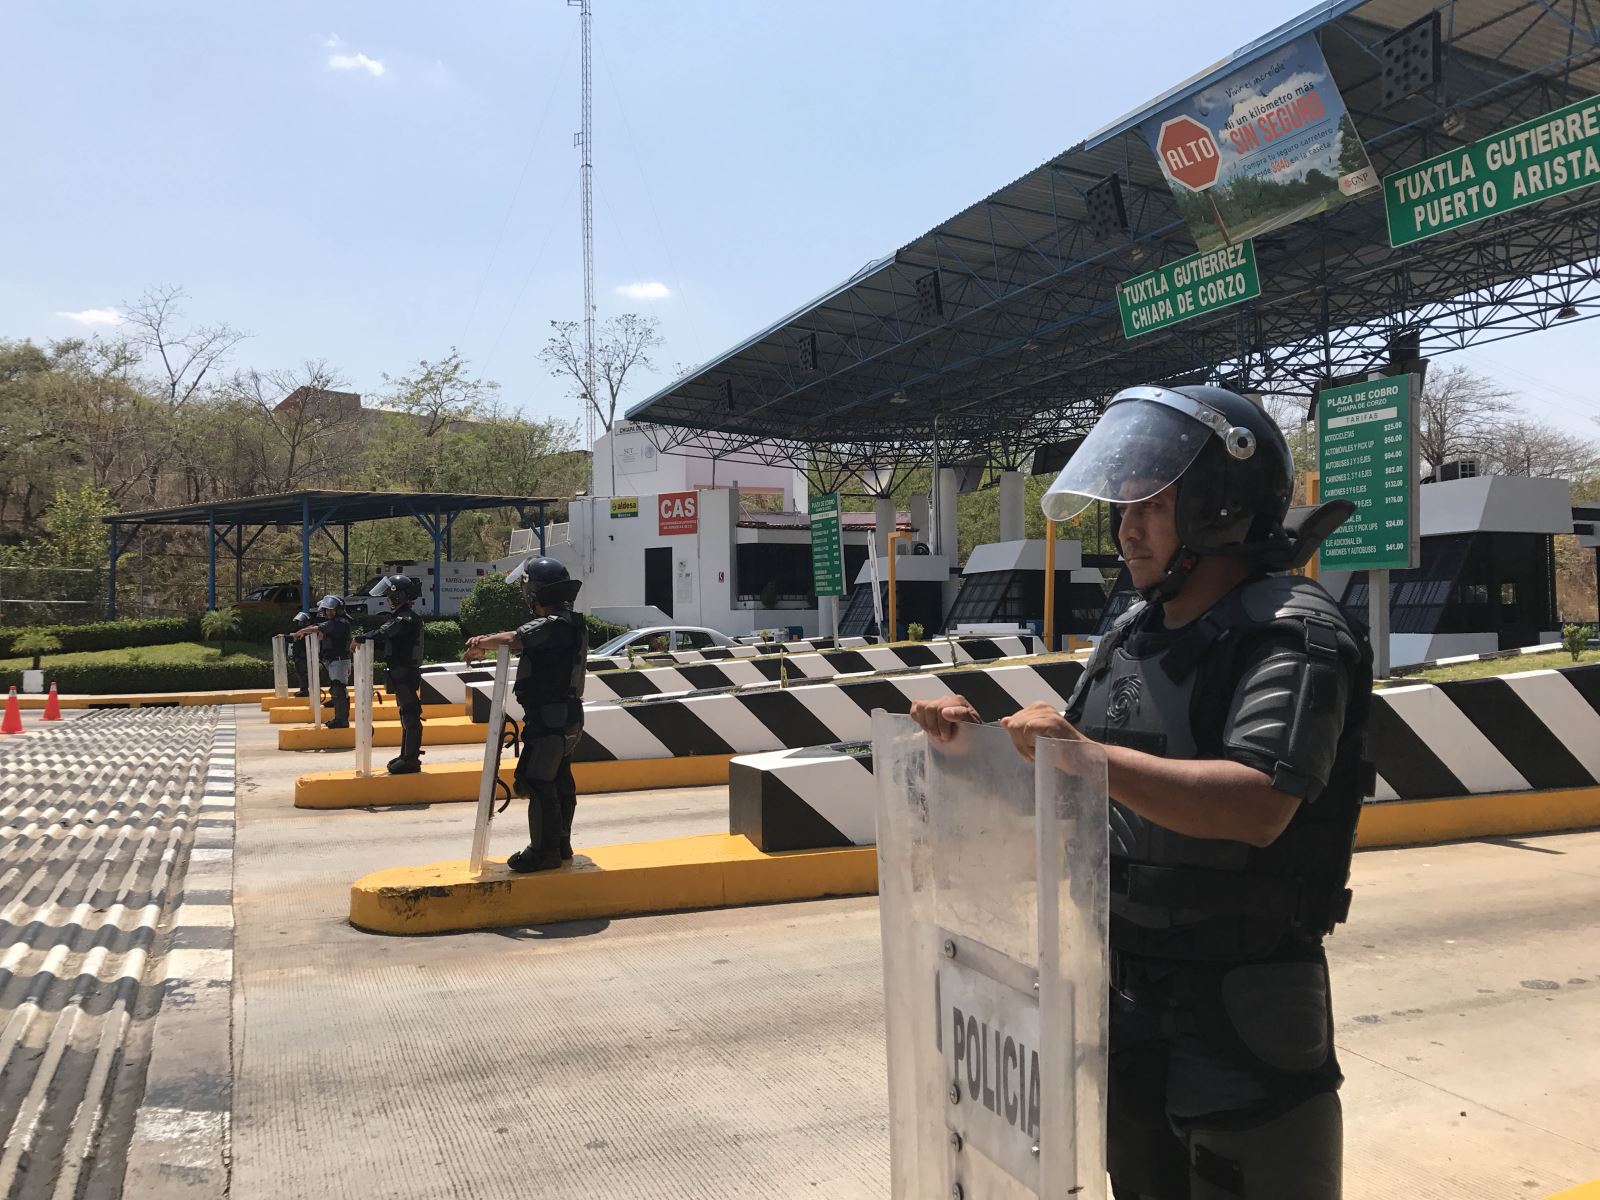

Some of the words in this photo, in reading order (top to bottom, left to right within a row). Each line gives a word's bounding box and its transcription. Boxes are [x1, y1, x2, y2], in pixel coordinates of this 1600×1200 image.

[1224, 118, 1234, 131] Ni
[1236, 114, 1248, 125] un
[1248, 92, 1293, 119] kilómetro
[1295, 81, 1315, 97] más
[1229, 123, 1260, 155] SIN
[1257, 90, 1326, 143] SEGURO
[1166, 136, 1215, 172] ALTO
[1243, 156, 1267, 173] Compra
[1268, 153, 1276, 161] tu
[1277, 143, 1299, 157] seguro
[1301, 128, 1334, 147] carretero
[1290, 156, 1299, 164] en
[1300, 152, 1307, 160] la
[1308, 141, 1332, 157] caseta
[1395, 153, 1476, 204] TUXTLA
[1486, 104, 1600, 171] GUTIERRE
[1351, 172, 1368, 186] GNP
[1413, 180, 1498, 232] PUERTO
[1513, 146, 1600, 200] ARISTA
[1123, 273, 1170, 306] TUXTLA
[1173, 243, 1247, 288] GUTIERREZ
[1131, 298, 1175, 330] CHIAPA
[1177, 290, 1195, 314] DE
[1198, 272, 1246, 307] CORZO
[1327, 395, 1353, 408] PLAZA
[1355, 391, 1367, 402] DE
[1368, 385, 1399, 400] COBRO
[1336, 404, 1357, 413] CHIAPA
[1366, 398, 1387, 408] CORZO
[1346, 412, 1379, 424] TARIFAS
[1356, 484, 1367, 493] EJES
[1361, 498, 1373, 508] EJES
[660, 497, 695, 519] CAS
[1385, 519, 1404, 528] $24.00
[953, 1005, 1041, 1137] POLICIA
